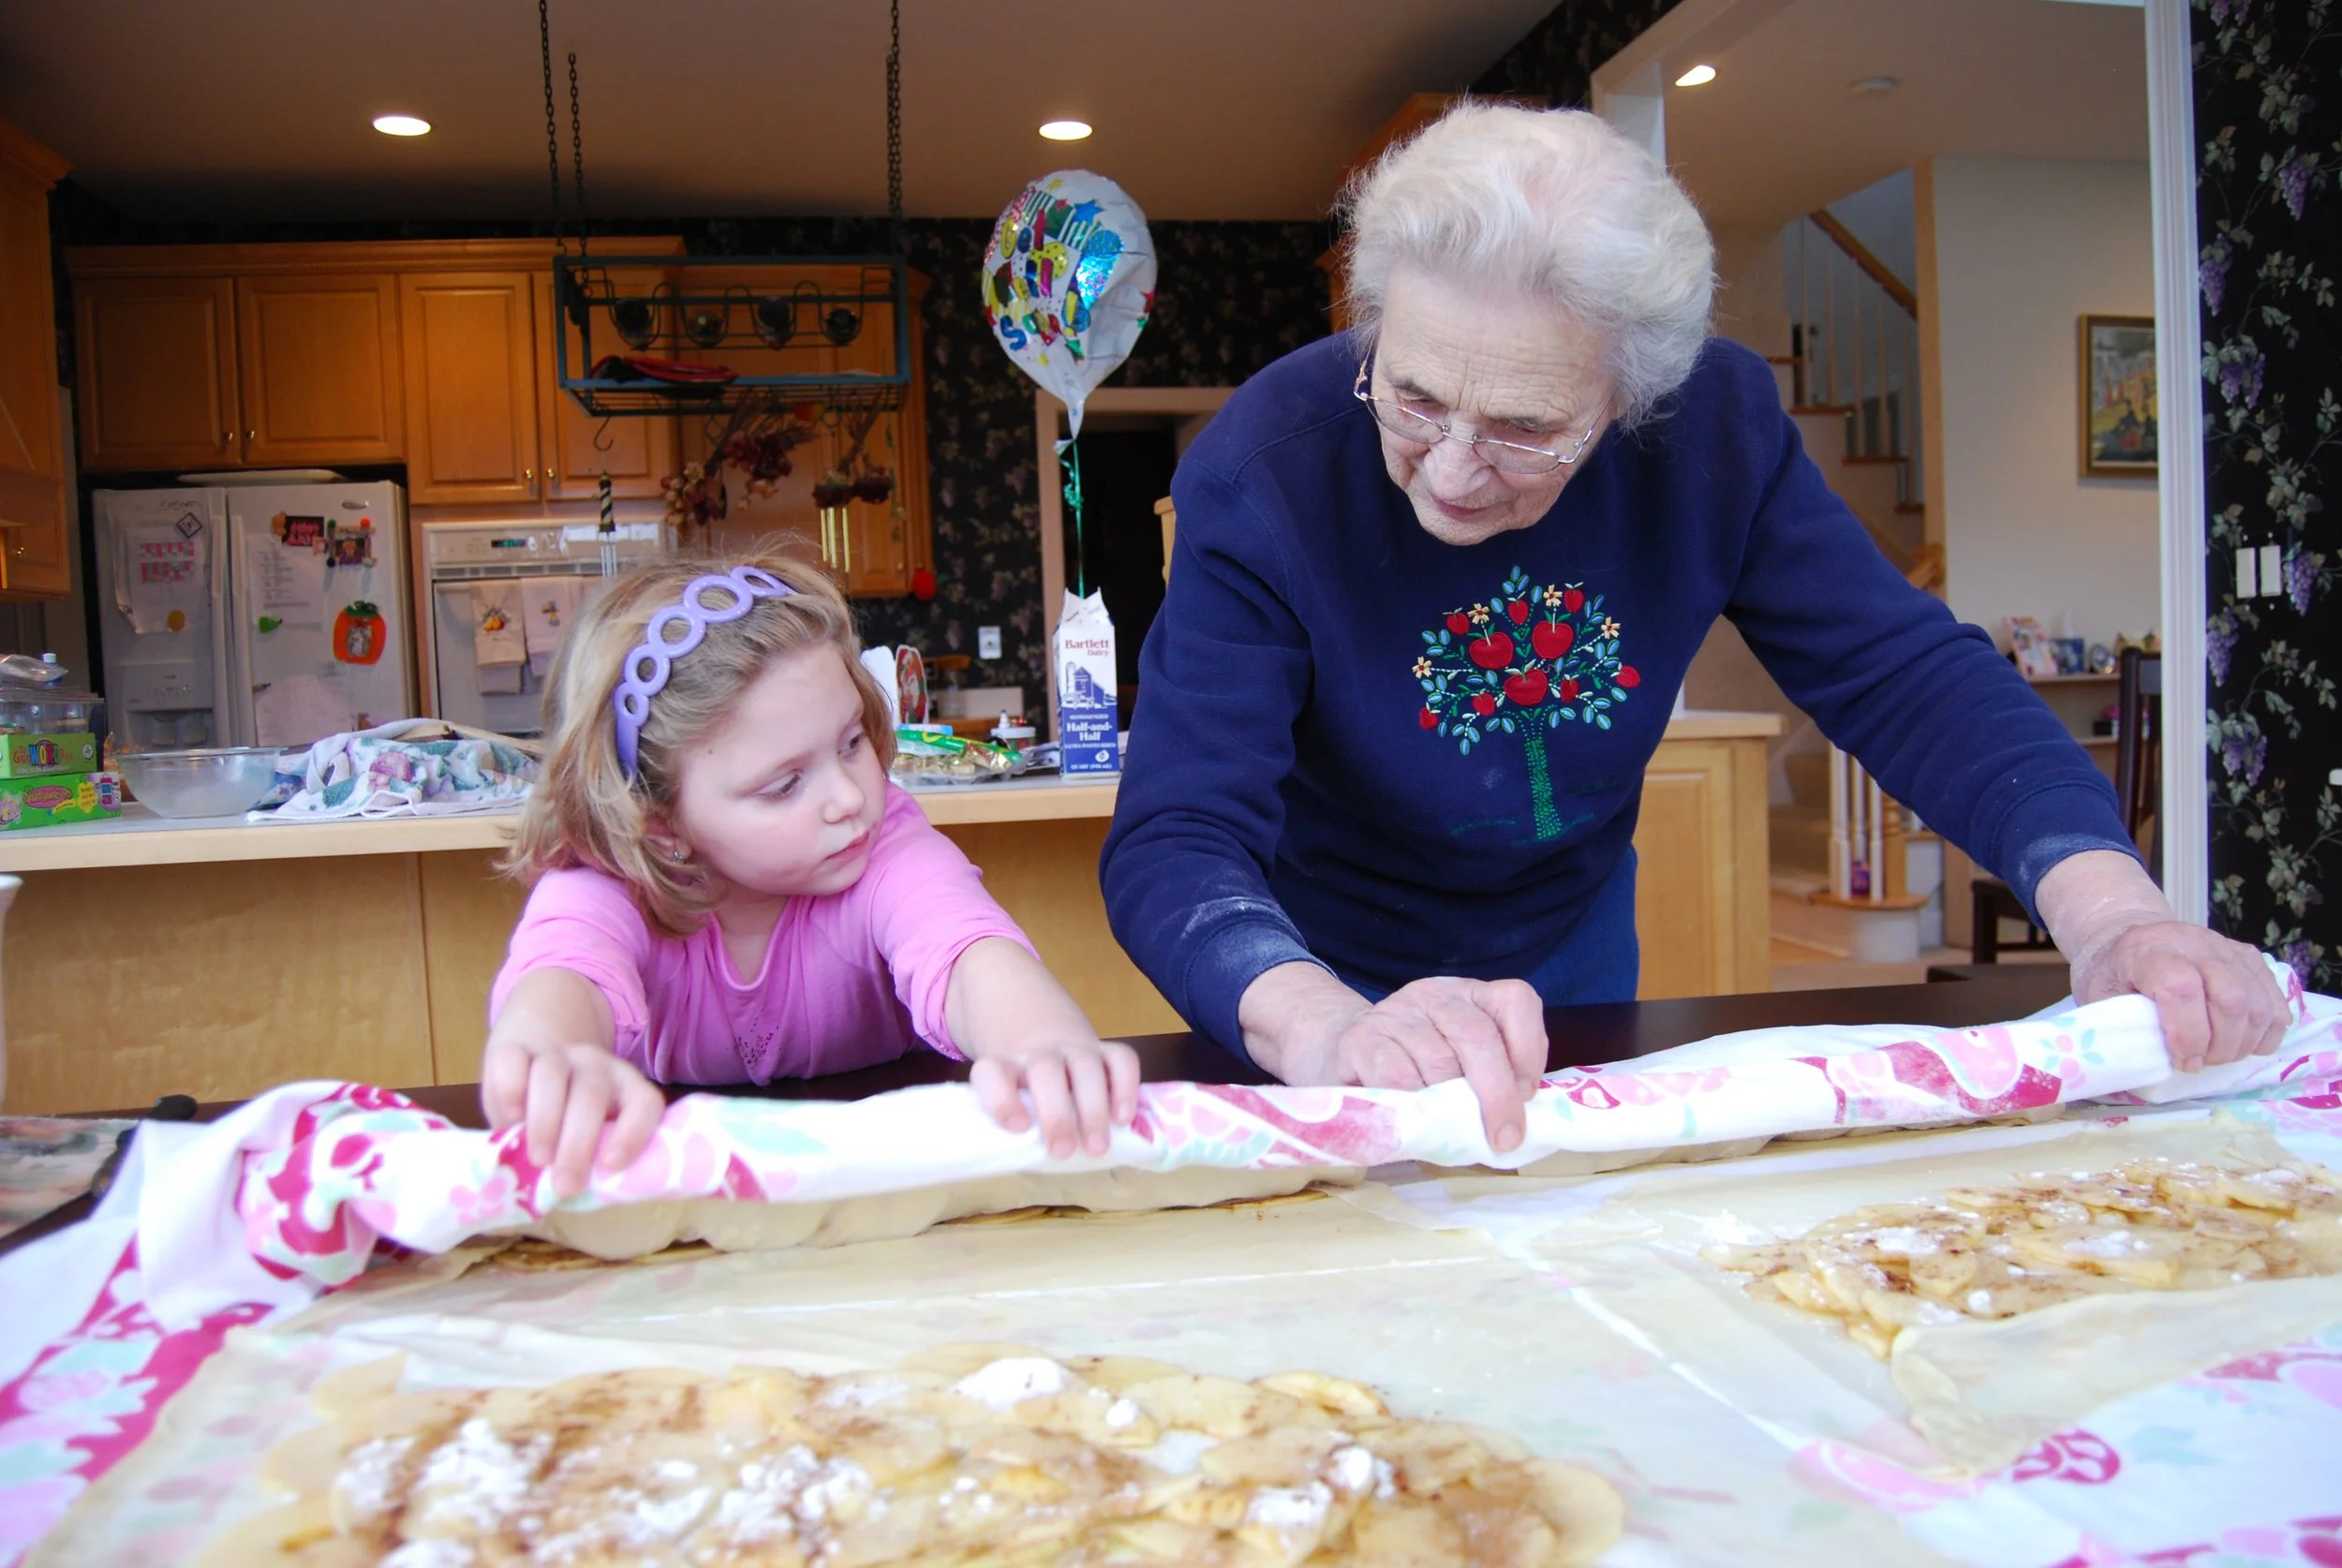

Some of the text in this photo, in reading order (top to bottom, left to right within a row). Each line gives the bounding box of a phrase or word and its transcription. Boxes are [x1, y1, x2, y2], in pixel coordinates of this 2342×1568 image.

[1064, 639, 1109, 649] Bartlett
[1087, 649, 1109, 658] Dairy
[1066, 721, 1113, 732] Half-and-
[1079, 732, 1101, 741] Half
